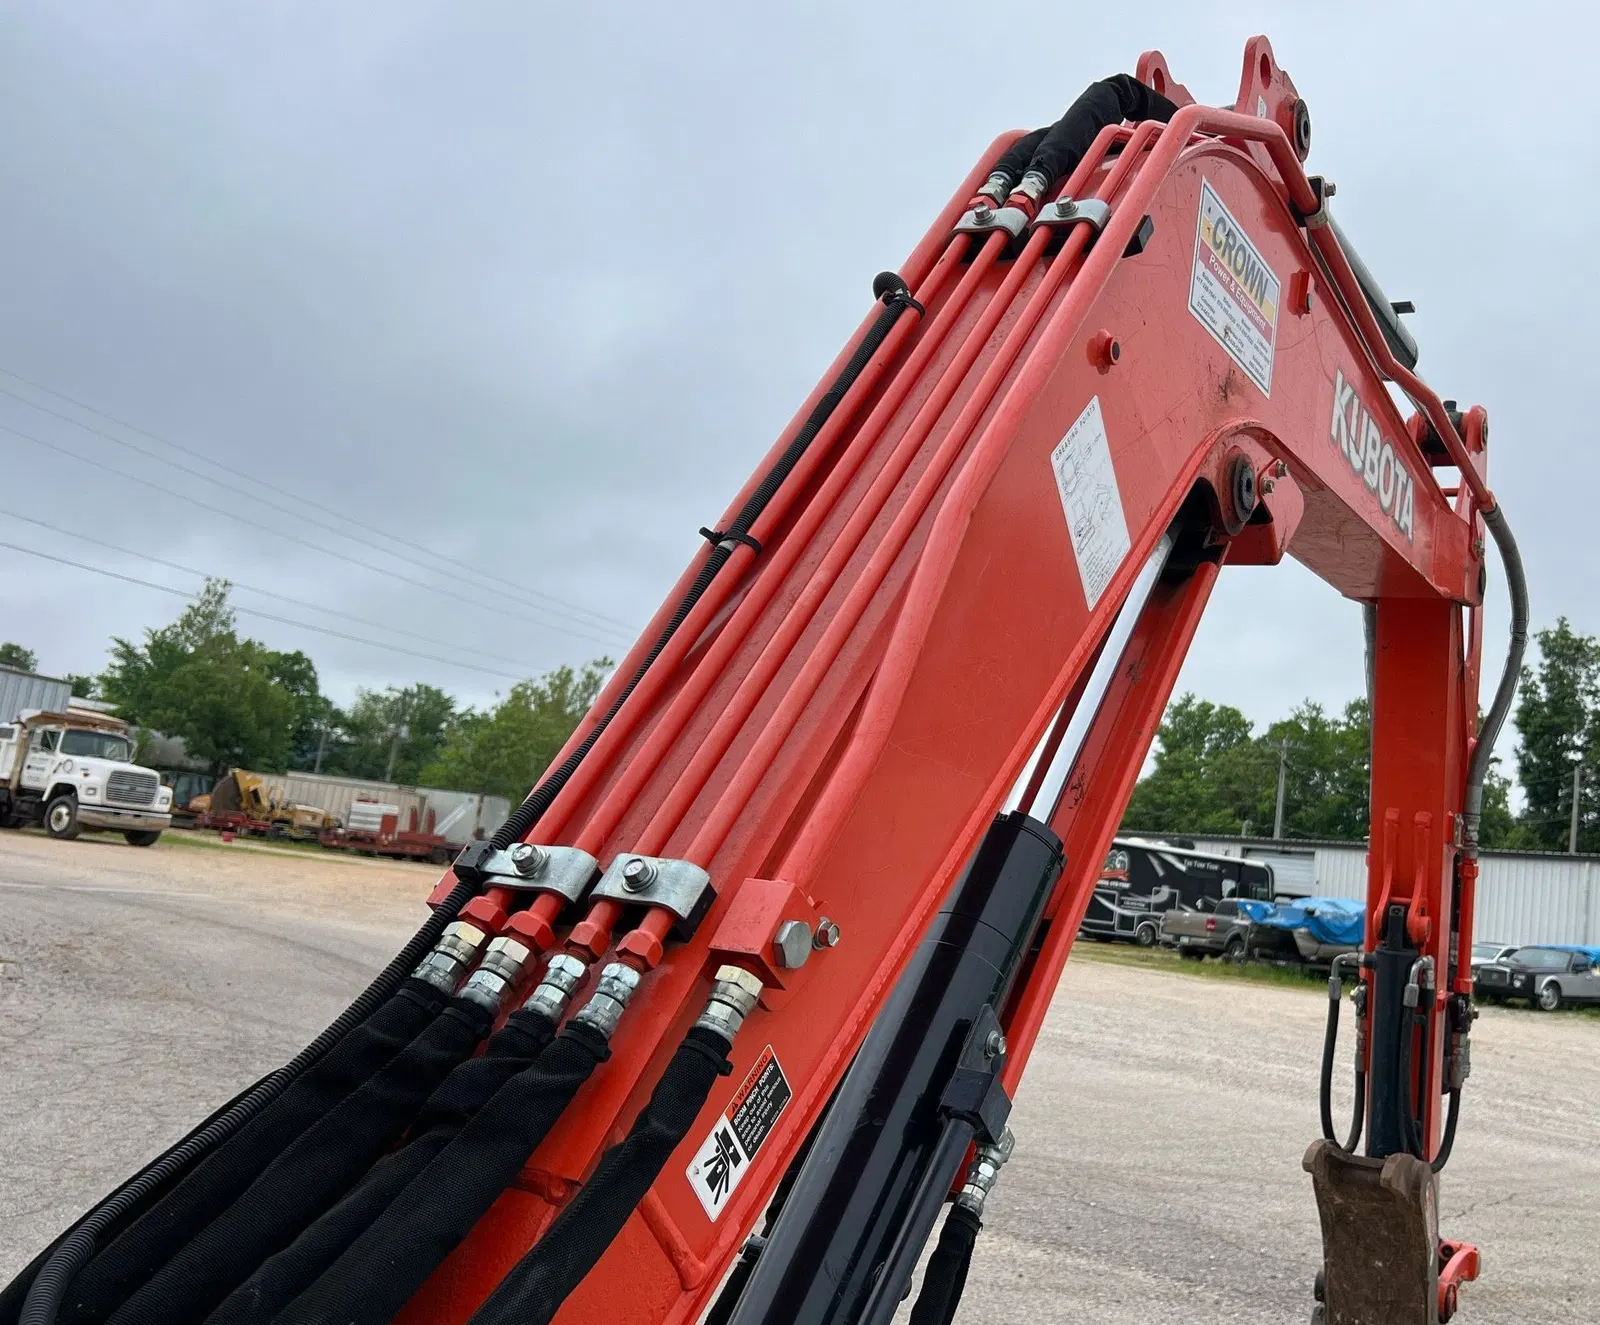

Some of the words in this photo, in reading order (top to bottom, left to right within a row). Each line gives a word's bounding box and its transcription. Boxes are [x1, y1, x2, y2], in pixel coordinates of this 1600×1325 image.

[1211, 215, 1269, 309] CROWN
[1209, 255, 1231, 285] Power
[1235, 287, 1267, 331] Equipment
[1055, 428, 1079, 461] GREASING
[1079, 403, 1096, 430] POINTS
[1330, 368, 1414, 543] KUBOTA
[733, 1106, 747, 1126] BOOM
[745, 1086, 759, 1106] PINCH
[737, 1055, 769, 1101] WARNING
[737, 1115, 750, 1133] Keep
[749, 1104, 757, 1115] out
[761, 1084, 770, 1096] this
[740, 1123, 752, 1140] area
[756, 1098, 768, 1117] avoid
[767, 1076, 782, 1099] serious
[744, 1118, 762, 1146] personal
[761, 1100, 773, 1119] injury
